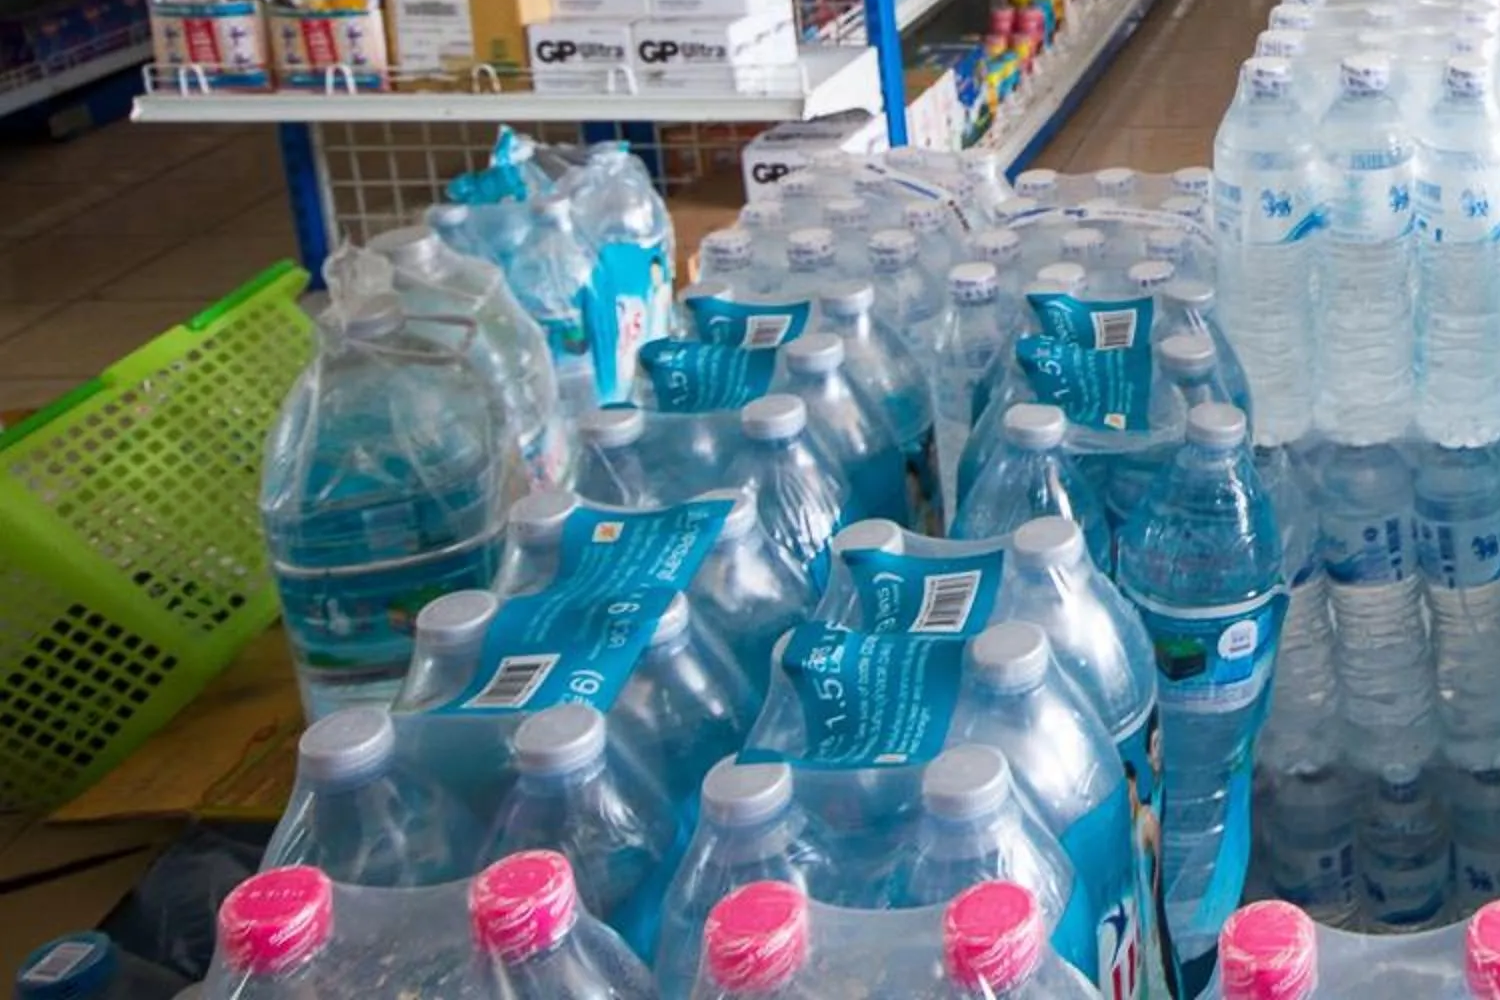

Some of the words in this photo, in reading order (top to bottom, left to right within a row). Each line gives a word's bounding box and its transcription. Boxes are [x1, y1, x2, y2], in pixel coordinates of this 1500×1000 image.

[537, 41, 576, 63] GP
[639, 40, 679, 63] GP
[752, 162, 787, 183] GP
